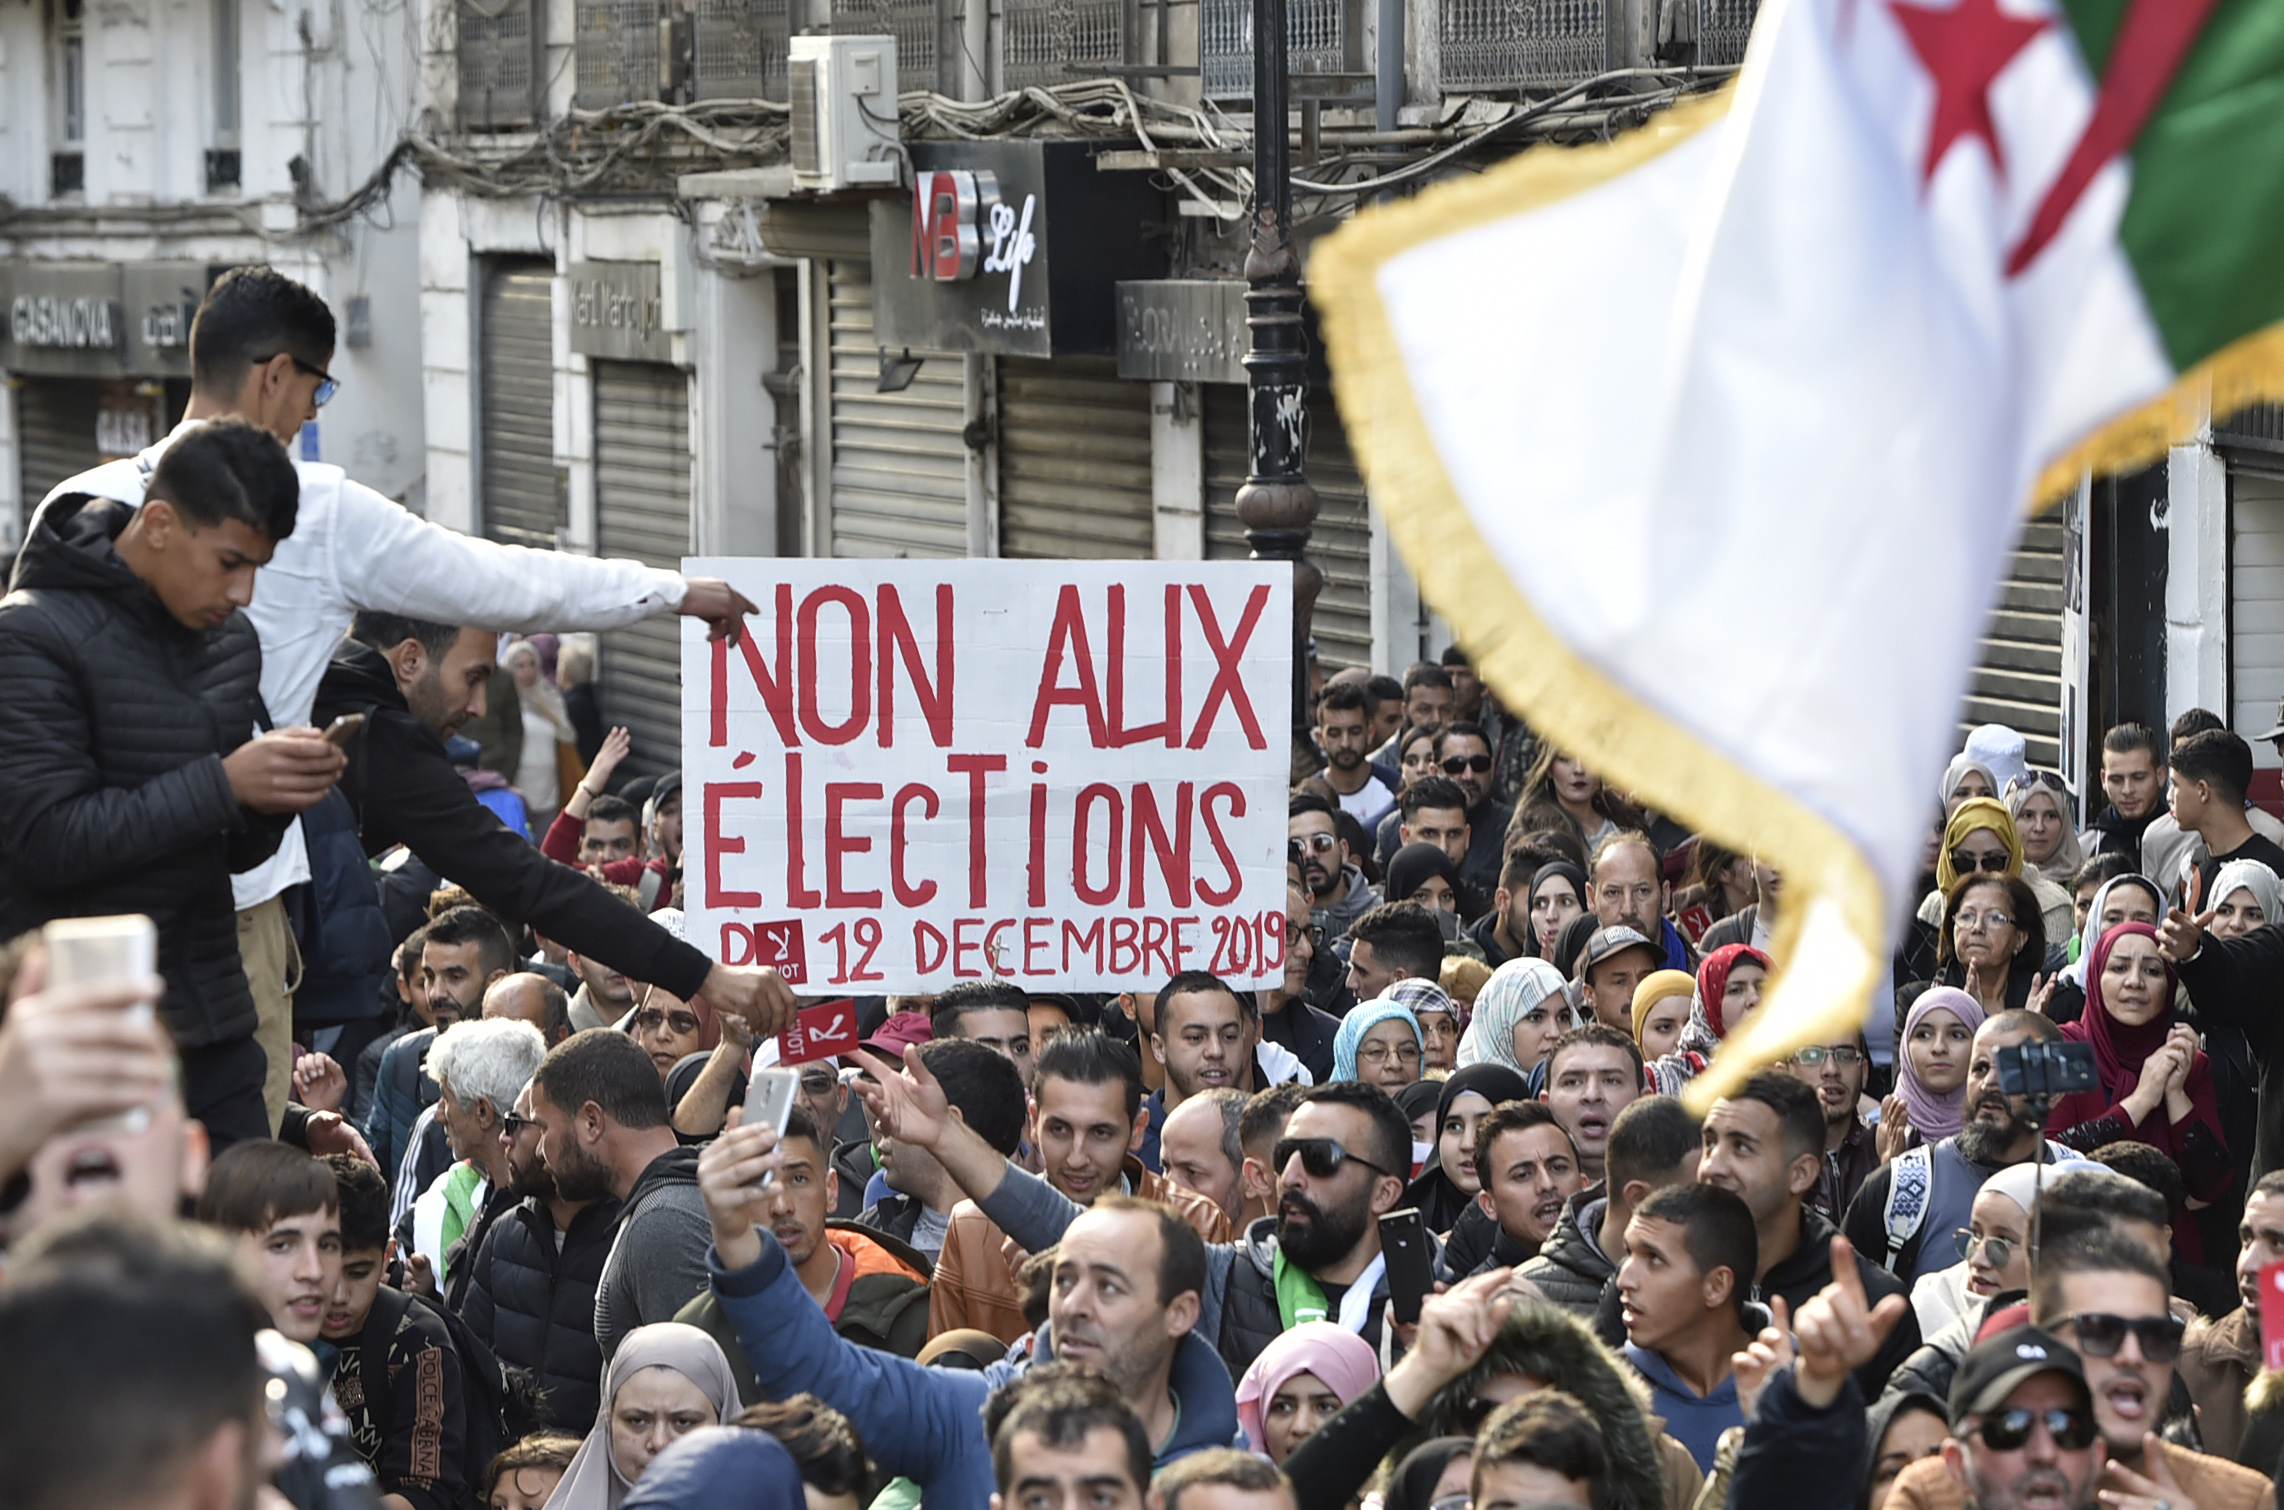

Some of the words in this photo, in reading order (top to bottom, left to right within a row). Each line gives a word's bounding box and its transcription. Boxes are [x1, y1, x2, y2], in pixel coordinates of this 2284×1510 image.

[709, 584, 954, 748] NON
[1026, 584, 1271, 749] AUX
[767, 926, 791, 961] لا
[818, 921, 885, 985] 12
[914, 917, 1199, 979] DECEMBRE
[1209, 911, 1286, 979] 2019
[423, 1350, 438, 1403] DOLCE
